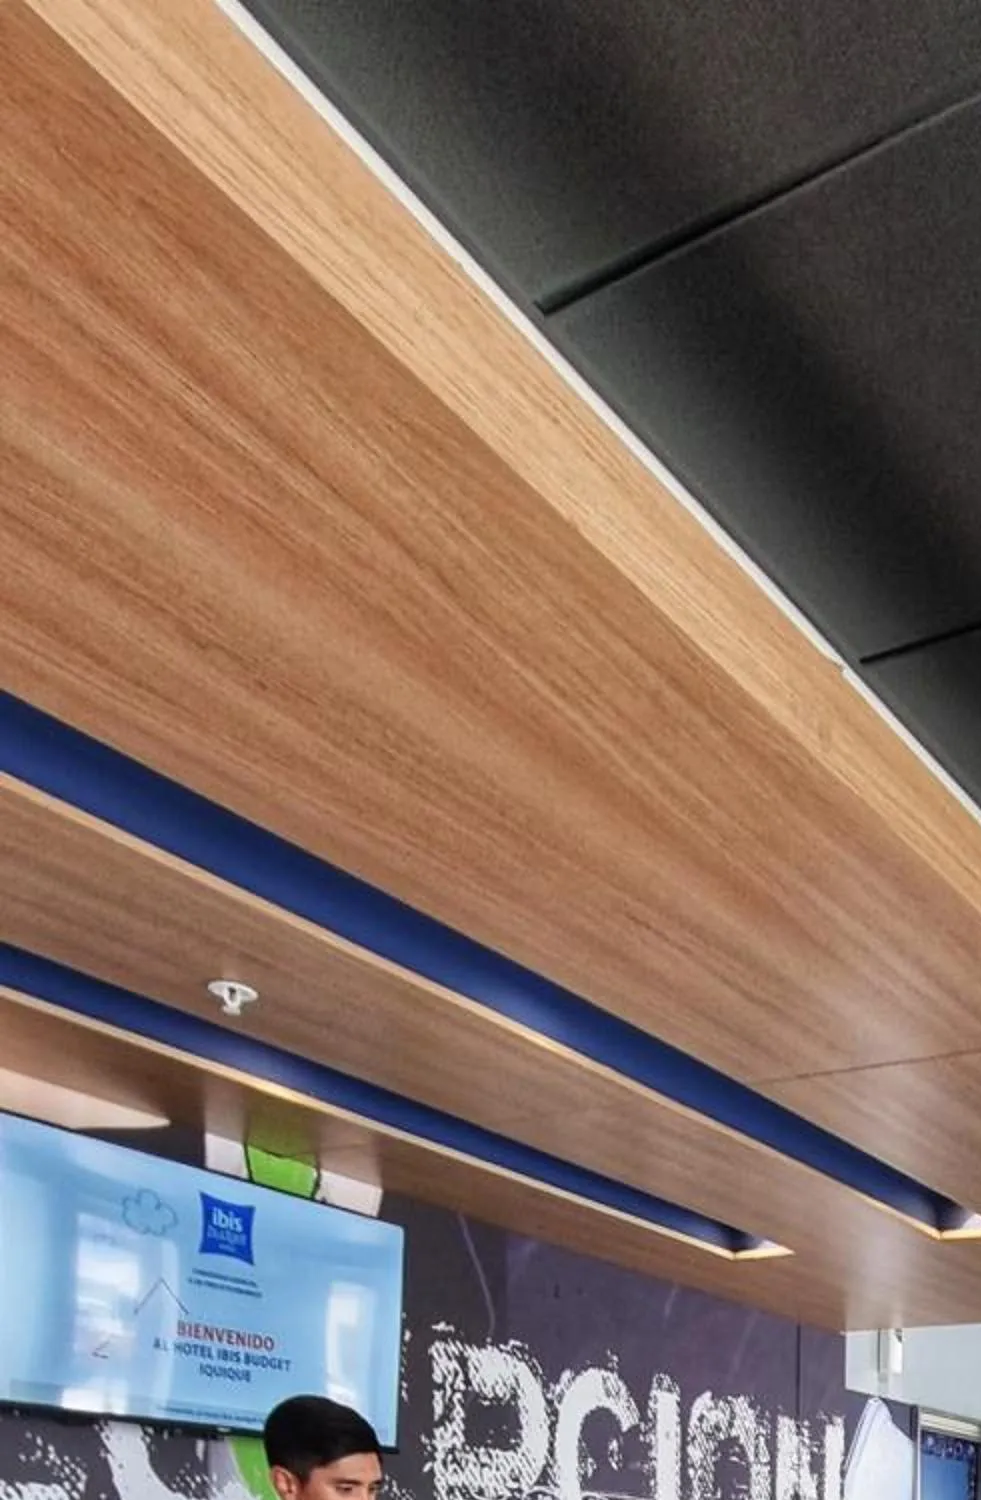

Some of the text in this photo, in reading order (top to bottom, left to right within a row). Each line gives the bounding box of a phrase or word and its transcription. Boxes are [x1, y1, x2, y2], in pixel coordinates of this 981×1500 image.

[212, 1206, 244, 1233] ibis
[177, 1319, 275, 1352] BIENVENIDO
[173, 1341, 214, 1361] HOTEL
[216, 1347, 241, 1364] IBIS
[243, 1352, 292, 1372] BUDGET
